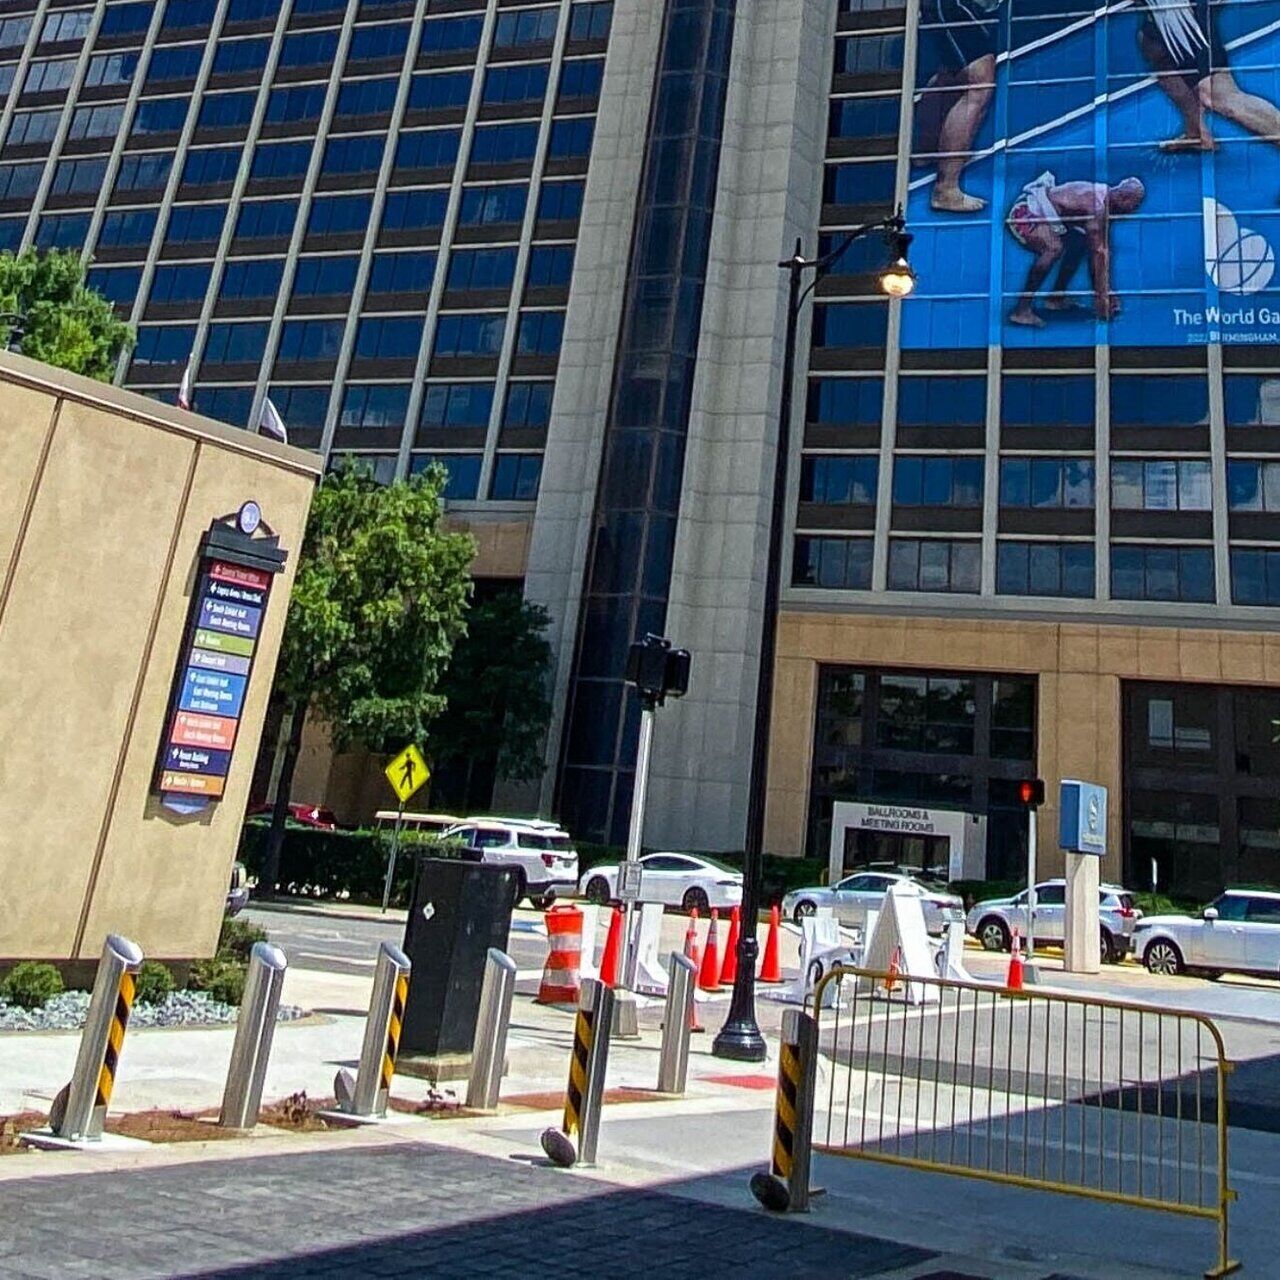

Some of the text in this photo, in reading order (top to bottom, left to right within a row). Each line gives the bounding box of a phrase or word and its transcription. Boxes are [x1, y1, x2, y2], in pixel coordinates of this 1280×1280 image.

[1173, 308, 1202, 325] The
[1205, 306, 1254, 324] World
[868, 806, 921, 819] BALLROOMS
[861, 818, 934, 832] MEETING ROOMS
